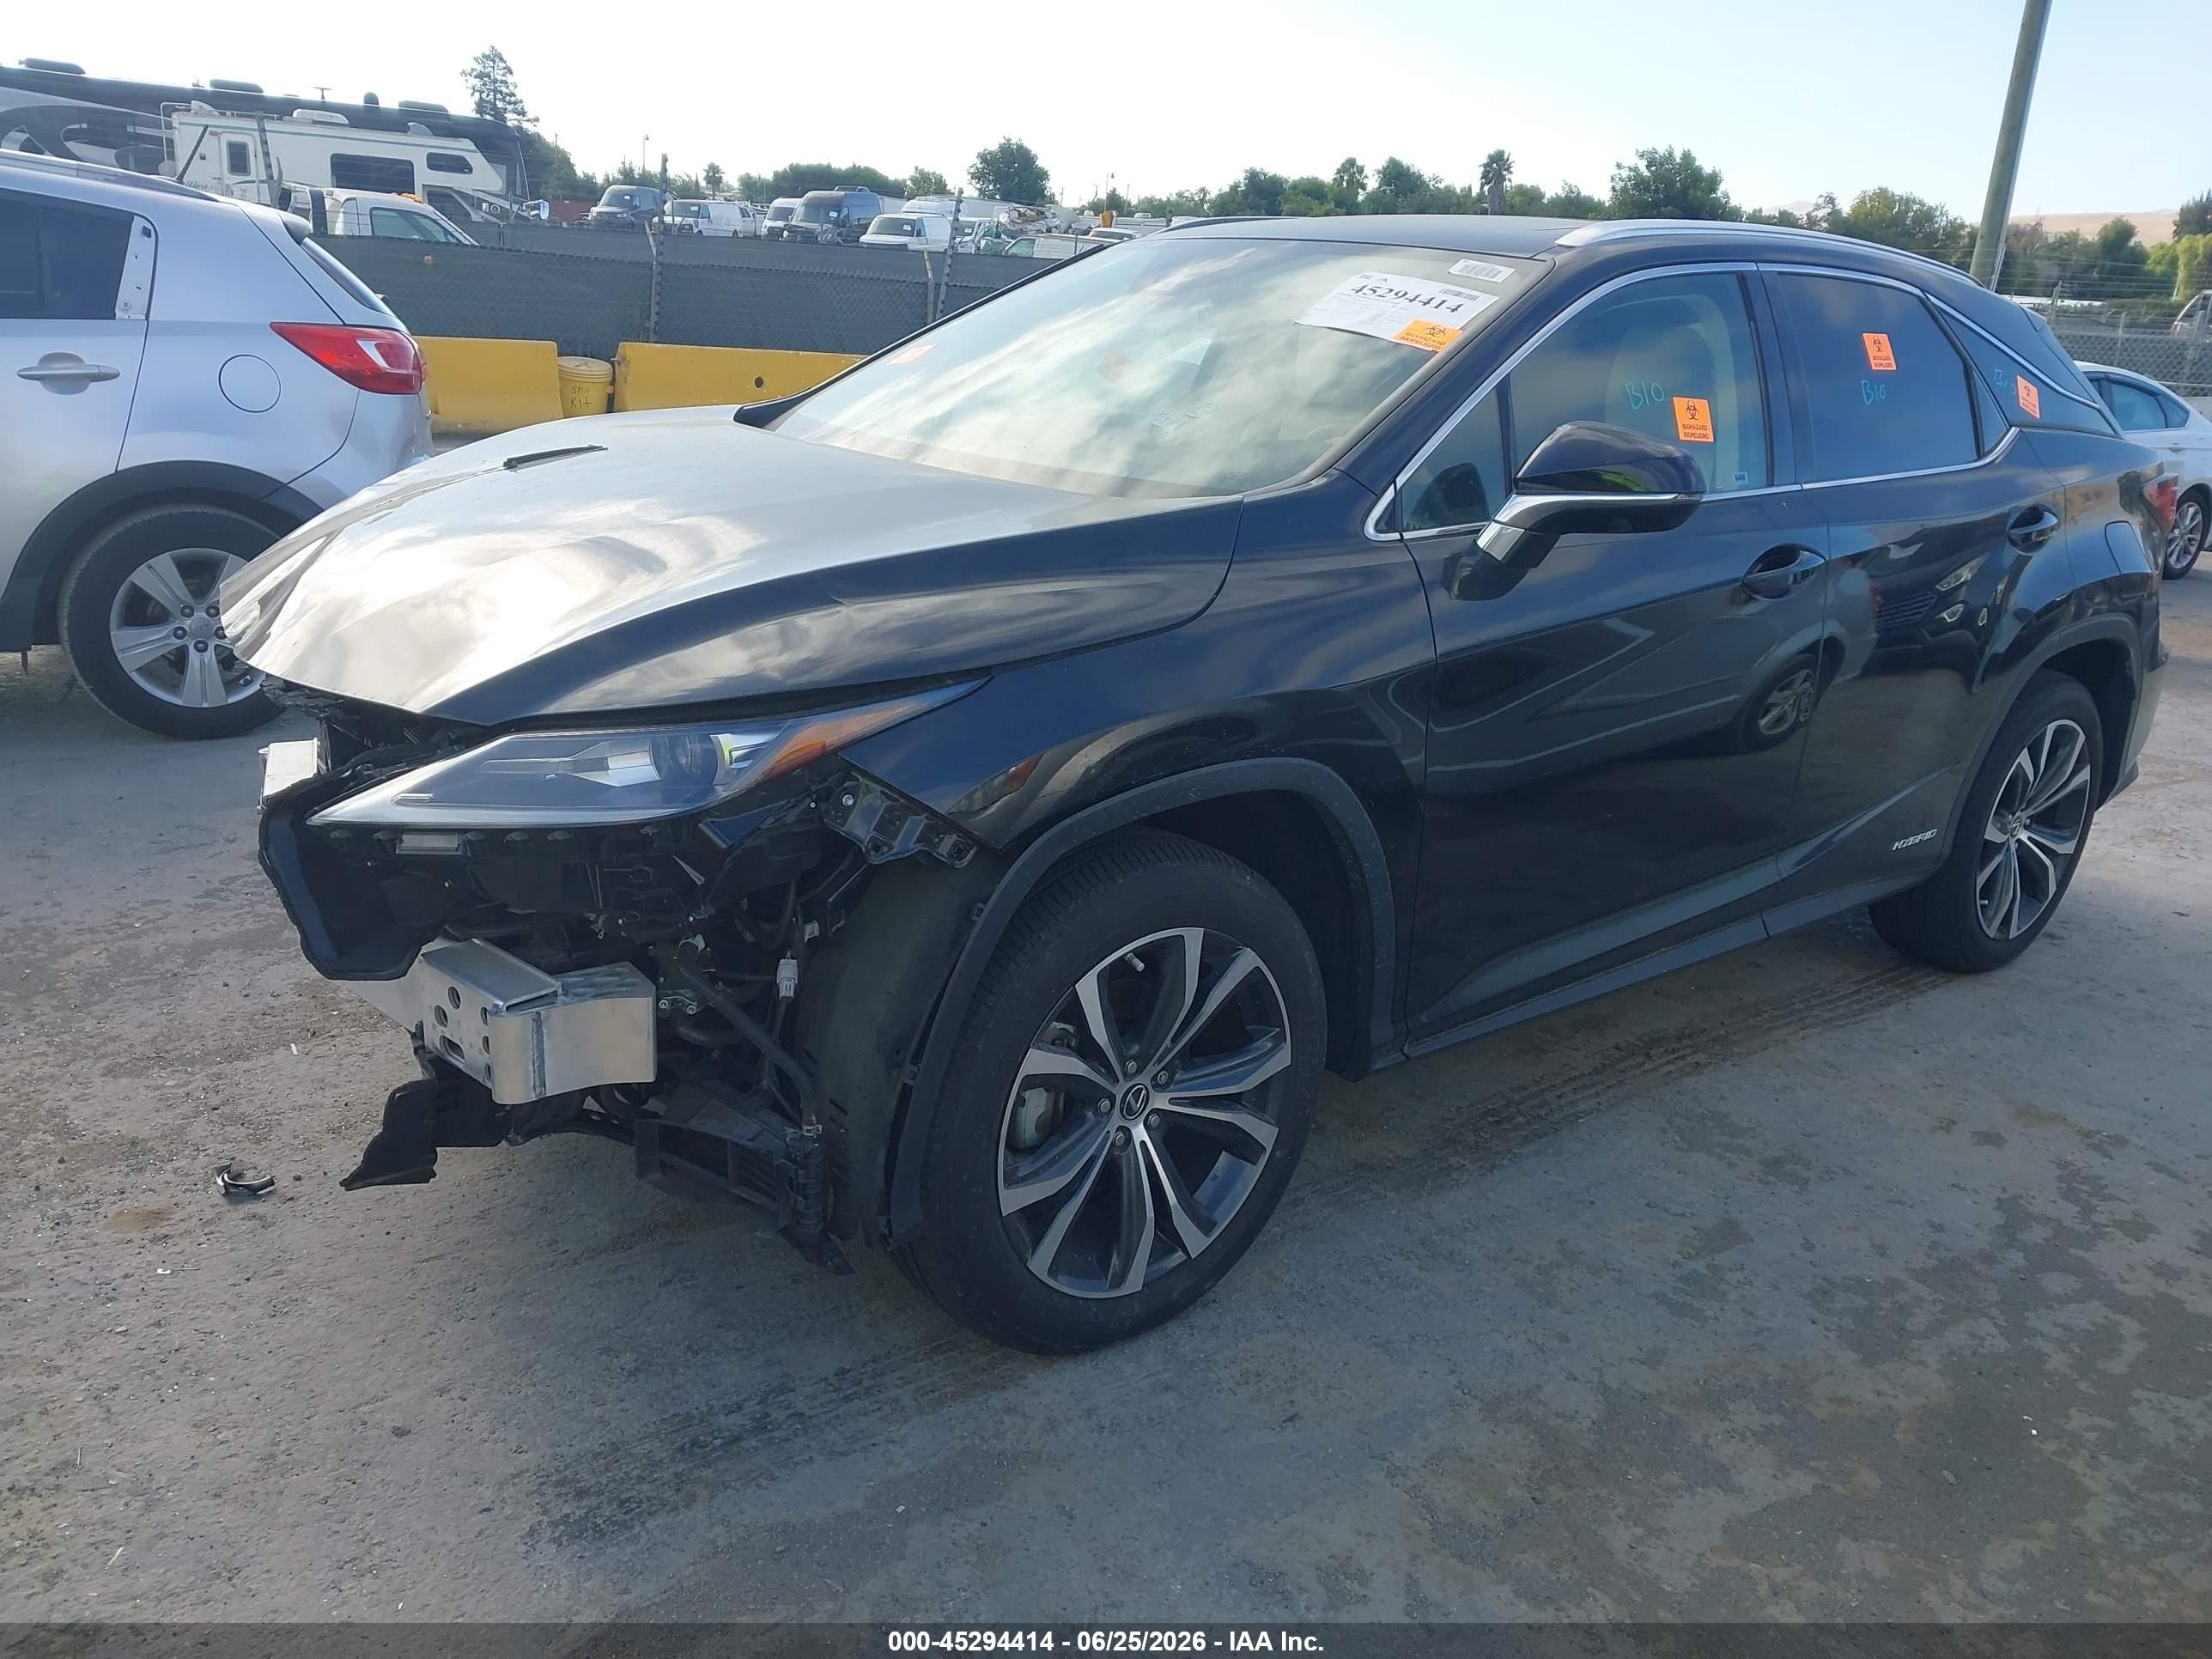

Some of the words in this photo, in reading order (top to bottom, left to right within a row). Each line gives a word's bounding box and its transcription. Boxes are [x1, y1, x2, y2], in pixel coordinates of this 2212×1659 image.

[1351, 284, 1464, 313] 45294414
[1623, 381, 1664, 410] BIO
[1683, 431, 1710, 440] BIOPELIGRO
[1892, 828, 1938, 851] HYBRID
